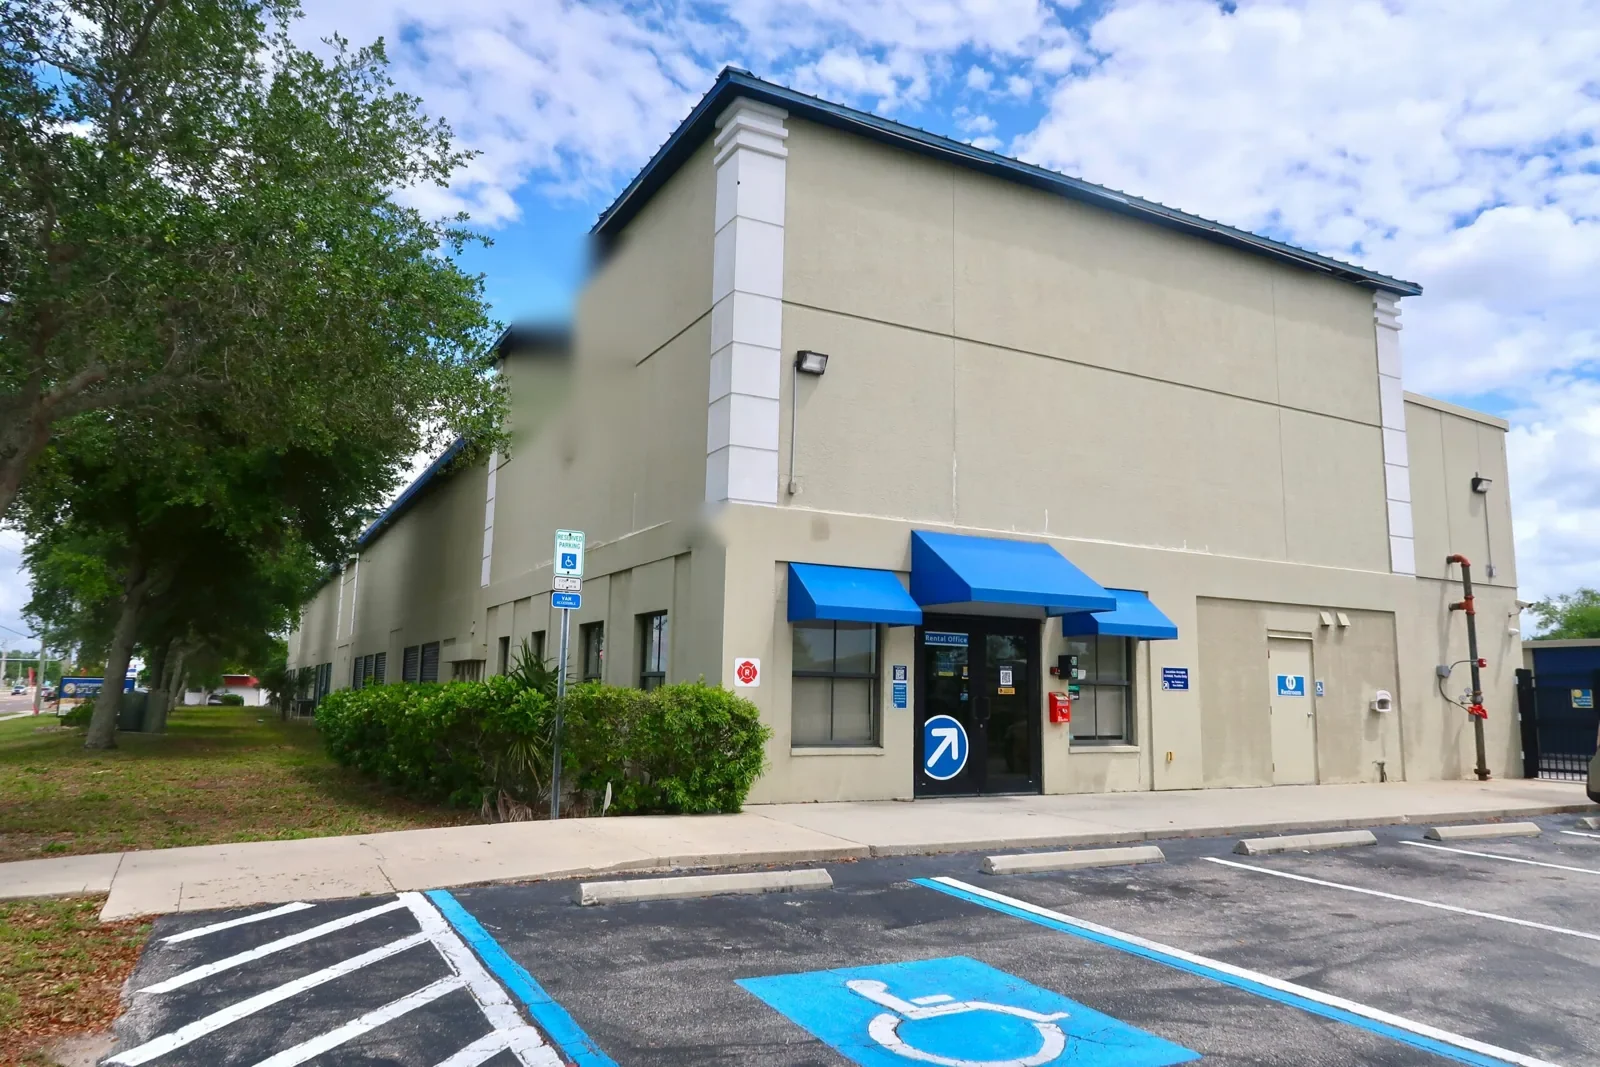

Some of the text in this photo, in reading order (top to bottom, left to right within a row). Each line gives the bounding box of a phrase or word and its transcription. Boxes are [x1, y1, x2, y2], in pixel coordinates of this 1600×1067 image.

[557, 533, 582, 542] RESERVED
[558, 541, 581, 550] PARKING
[925, 634, 968, 644] Rental Office
